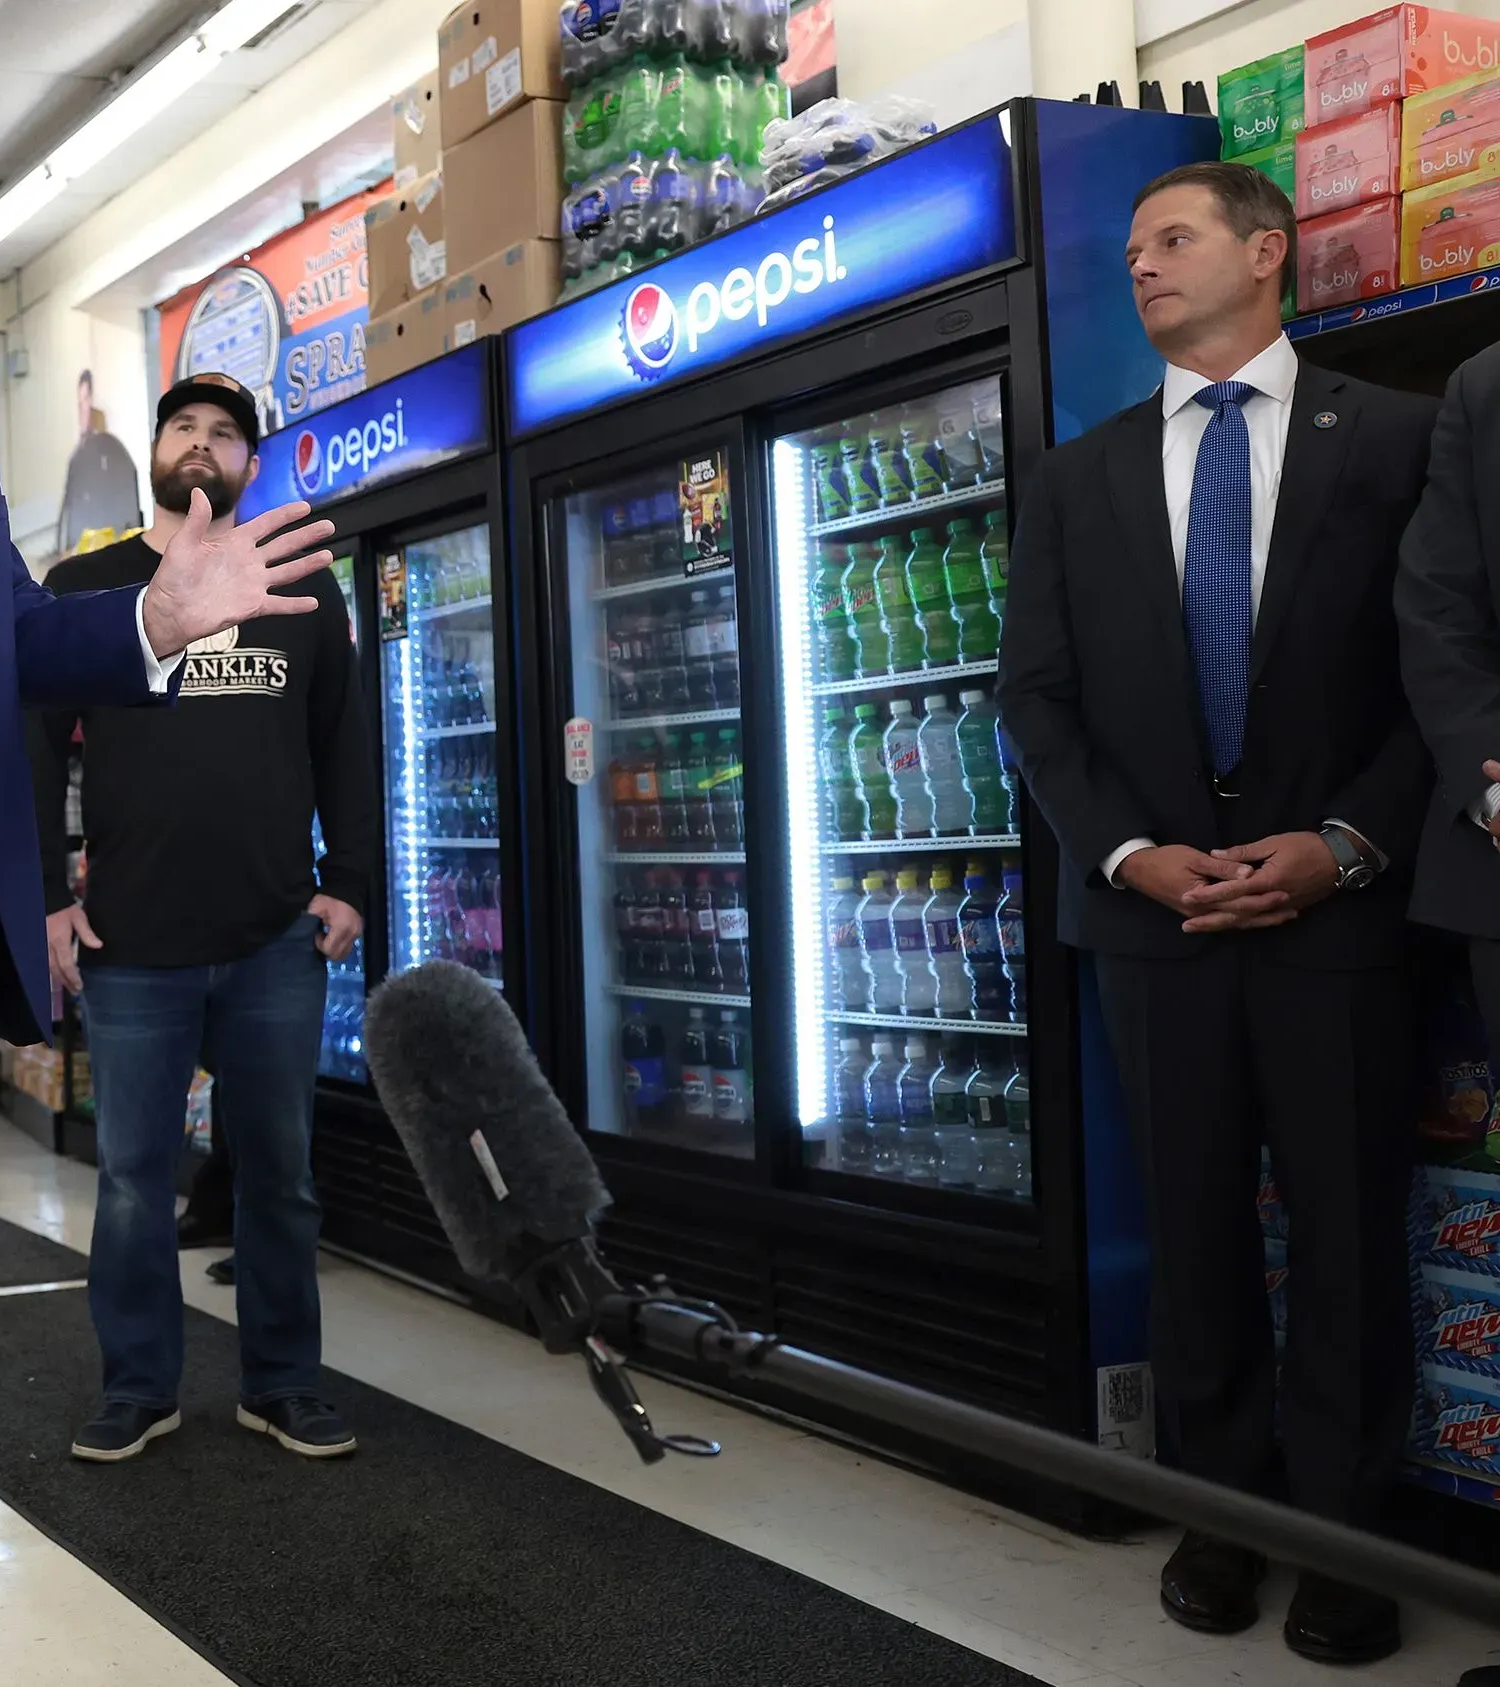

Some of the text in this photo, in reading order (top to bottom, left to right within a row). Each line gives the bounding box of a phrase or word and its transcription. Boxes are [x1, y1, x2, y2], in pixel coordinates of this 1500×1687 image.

[1321, 81, 1368, 106] bubly
[1233, 115, 1279, 139] bubly
[1420, 147, 1475, 174] bubly
[1311, 176, 1358, 200] bubly
[1419, 246, 1475, 270] bubly
[687, 214, 837, 353] pepsi
[1312, 270, 1359, 291] bubly
[1367, 299, 1402, 319] pepsi
[326, 398, 404, 486] pepsi
[690, 468, 716, 484] WE GO
[692, 459, 712, 474] HERE
[183, 656, 288, 689] ANKLE'S
[230, 676, 269, 686] MARKET
[1470, 1243, 1490, 1257] CHILL
[1471, 1344, 1491, 1357] CHILL
[1471, 1445, 1491, 1457] CHILL
